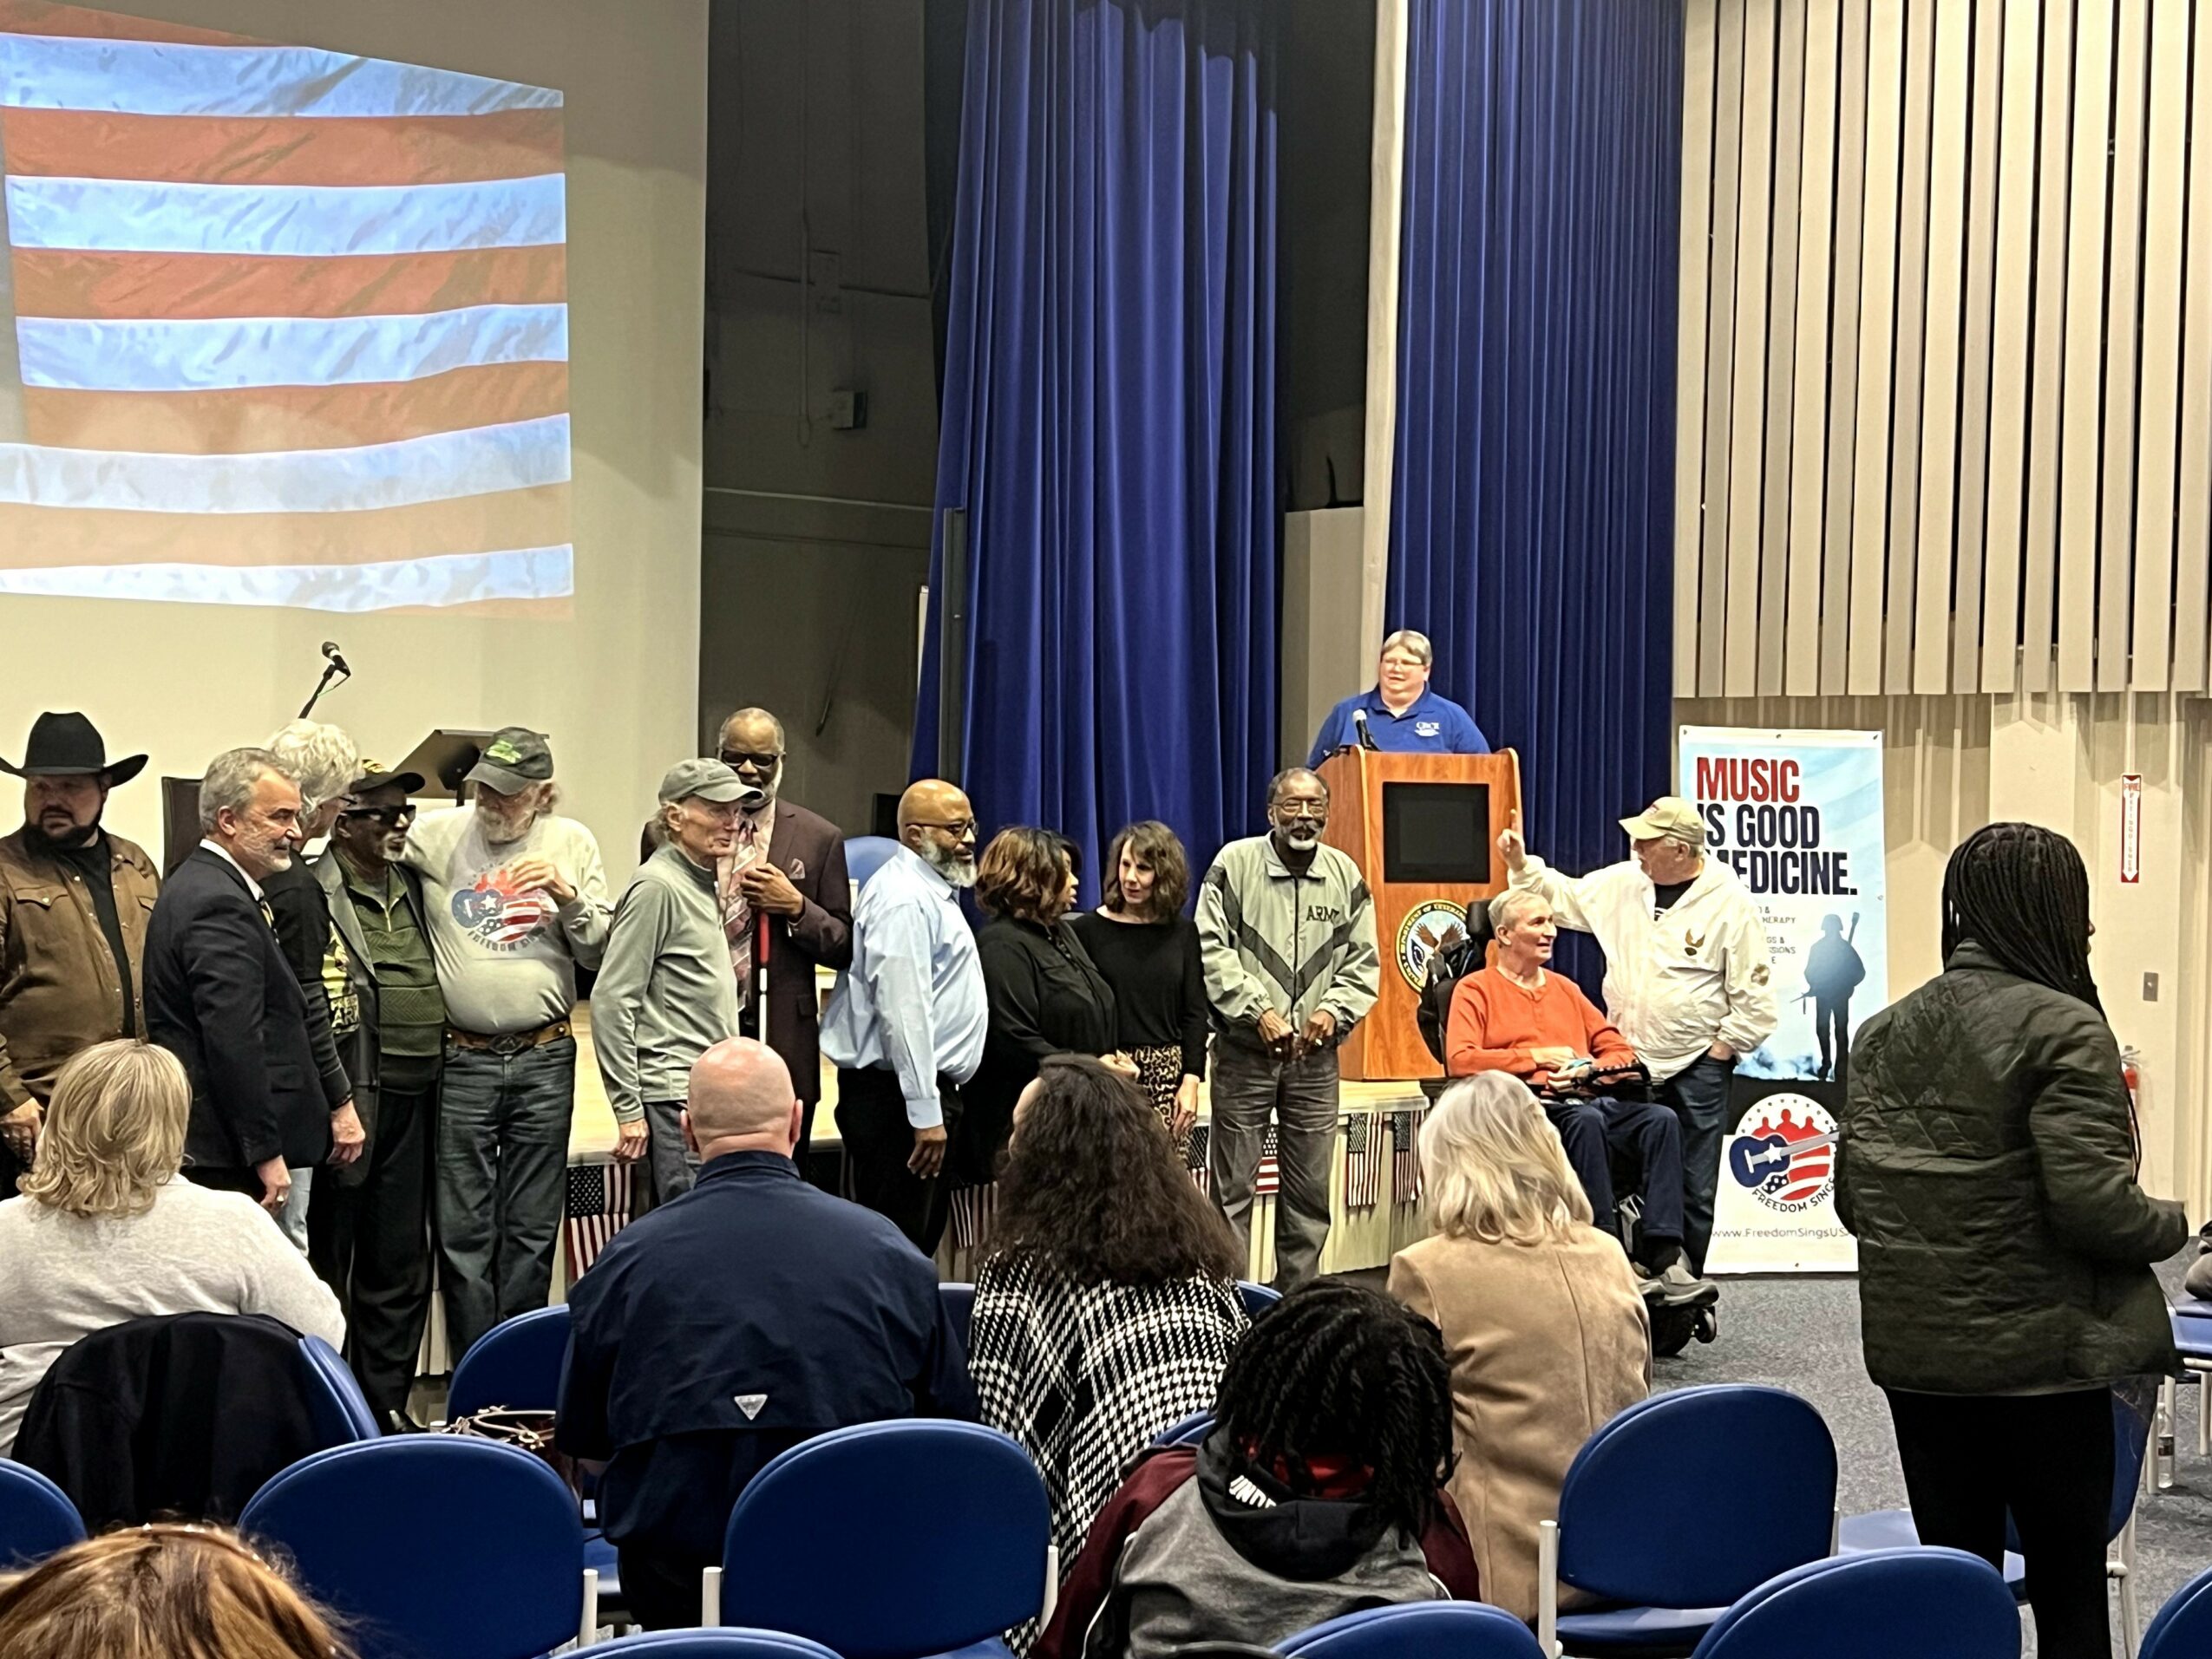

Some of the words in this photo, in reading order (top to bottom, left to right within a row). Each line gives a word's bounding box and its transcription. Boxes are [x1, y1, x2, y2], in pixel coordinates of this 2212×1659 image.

[1697, 757, 1800, 802] MUSIC
[1737, 805, 1820, 849] GOOD
[1751, 1188, 1808, 1212] FREEDOM
[1711, 1227, 1849, 1240] www.FreedomSingsUS
